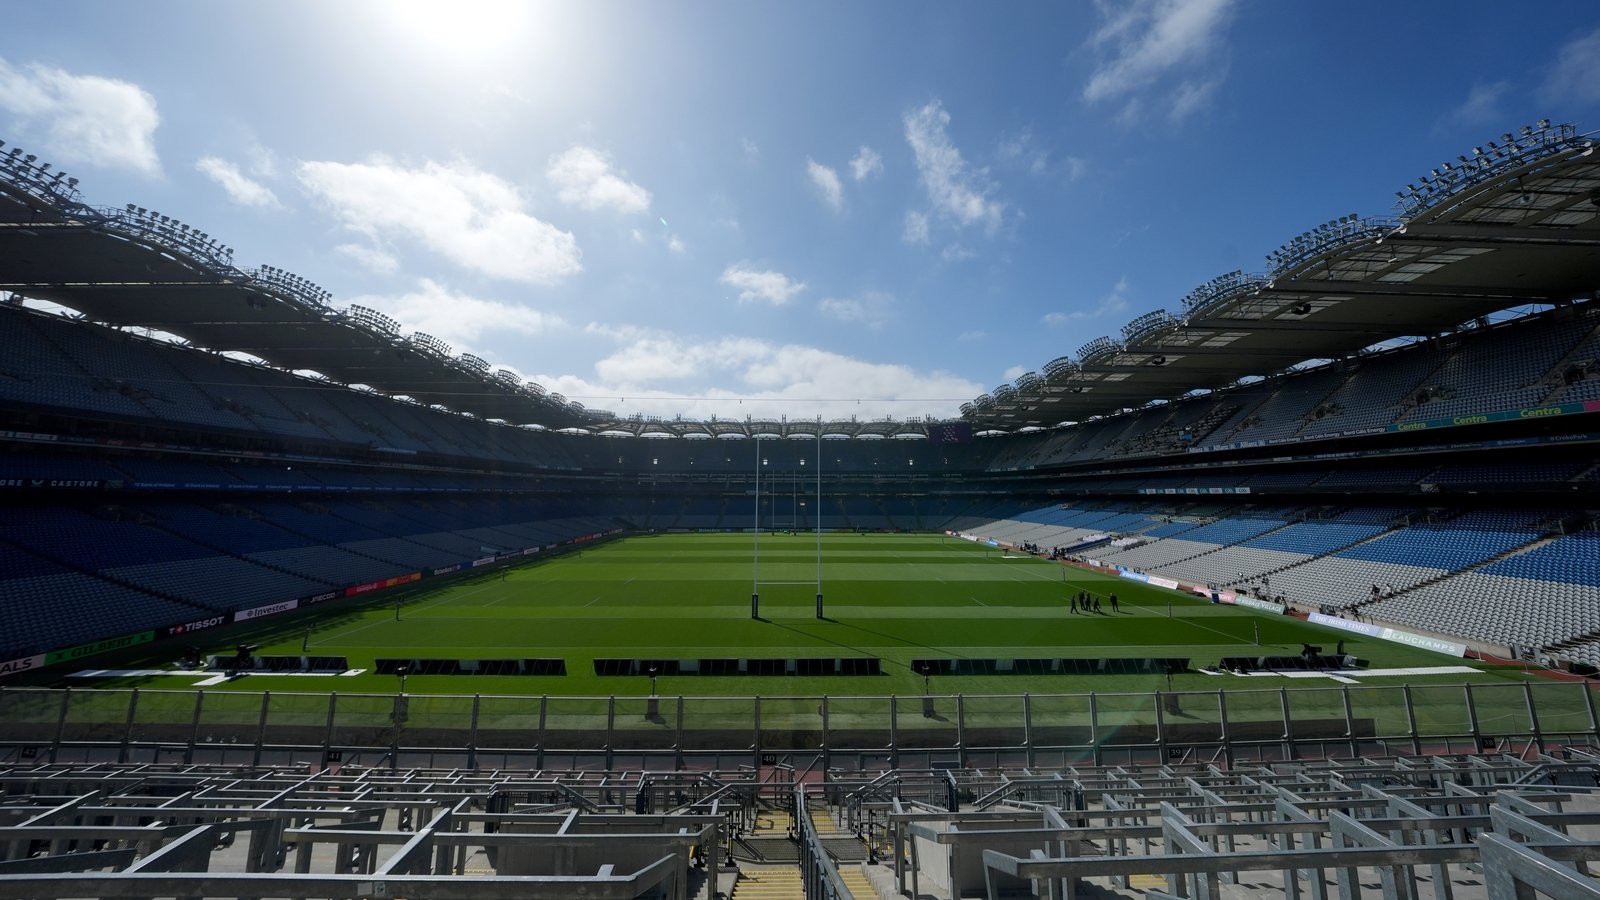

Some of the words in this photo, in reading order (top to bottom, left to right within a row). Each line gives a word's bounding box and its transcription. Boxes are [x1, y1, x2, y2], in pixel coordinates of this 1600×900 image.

[1520, 407, 1562, 417] Centra
[1453, 415, 1488, 425] Centra
[1367, 426, 1386, 435] Energy
[1398, 422, 1426, 431] Centra
[50, 480, 100, 488] CASTORE
[254, 603, 289, 617] Investec
[185, 615, 225, 632] TISSOT
[1315, 615, 1327, 623] THE
[1328, 618, 1347, 628] IRISH
[1347, 622, 1370, 632] TIMES
[1383, 627, 1456, 653] BEAUCHAMPS
[71, 636, 134, 658] GILBERT
[0, 658, 32, 674] ALS
[1171, 748, 1182, 757] 39
[763, 754, 776, 763] 40
